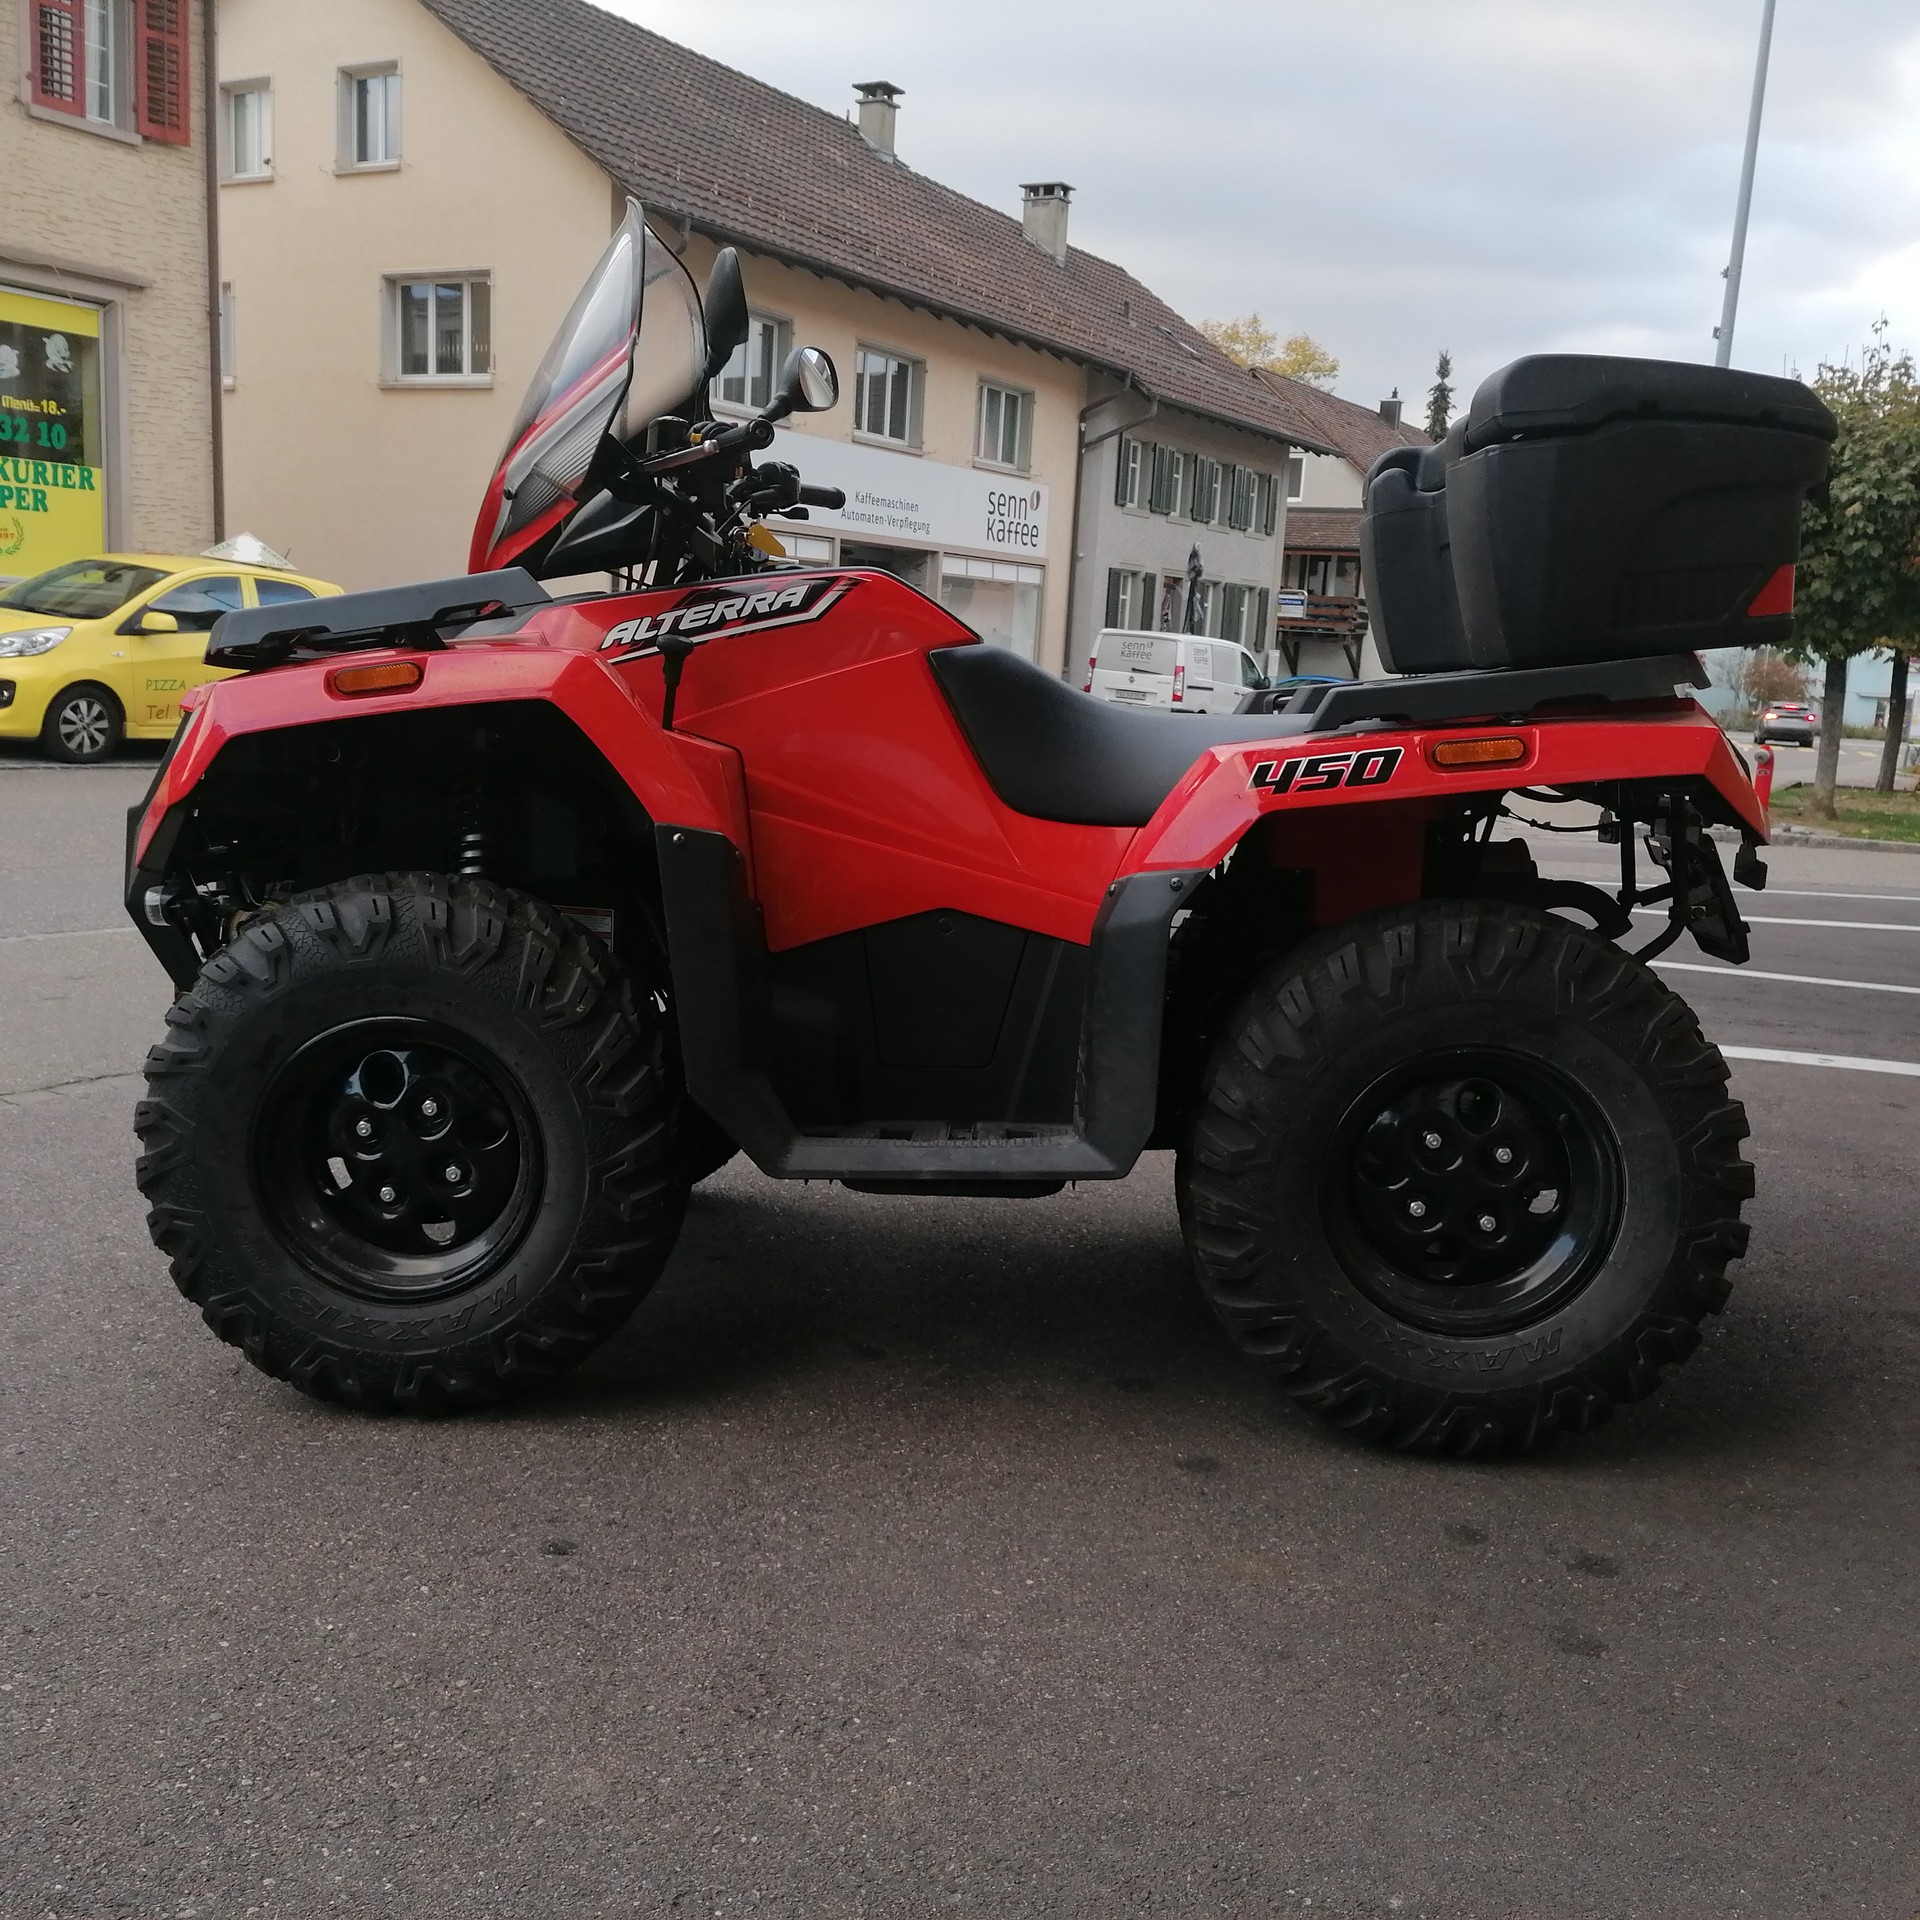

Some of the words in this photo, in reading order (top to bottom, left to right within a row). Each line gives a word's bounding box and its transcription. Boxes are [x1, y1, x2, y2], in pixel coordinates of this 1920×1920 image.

[0, 413, 30, 443] 32
[36, 421, 67, 450] 10
[855, 491, 919, 513] Kaffeemaschinen
[987, 491, 1028, 521] senn
[840, 507, 931, 535] Automaten-Verpflegung
[987, 517, 1039, 547] Kaffee
[600, 584, 810, 650] ALTERRA
[145, 679, 187, 692] PIZZA
[1246, 746, 1405, 796] 450
